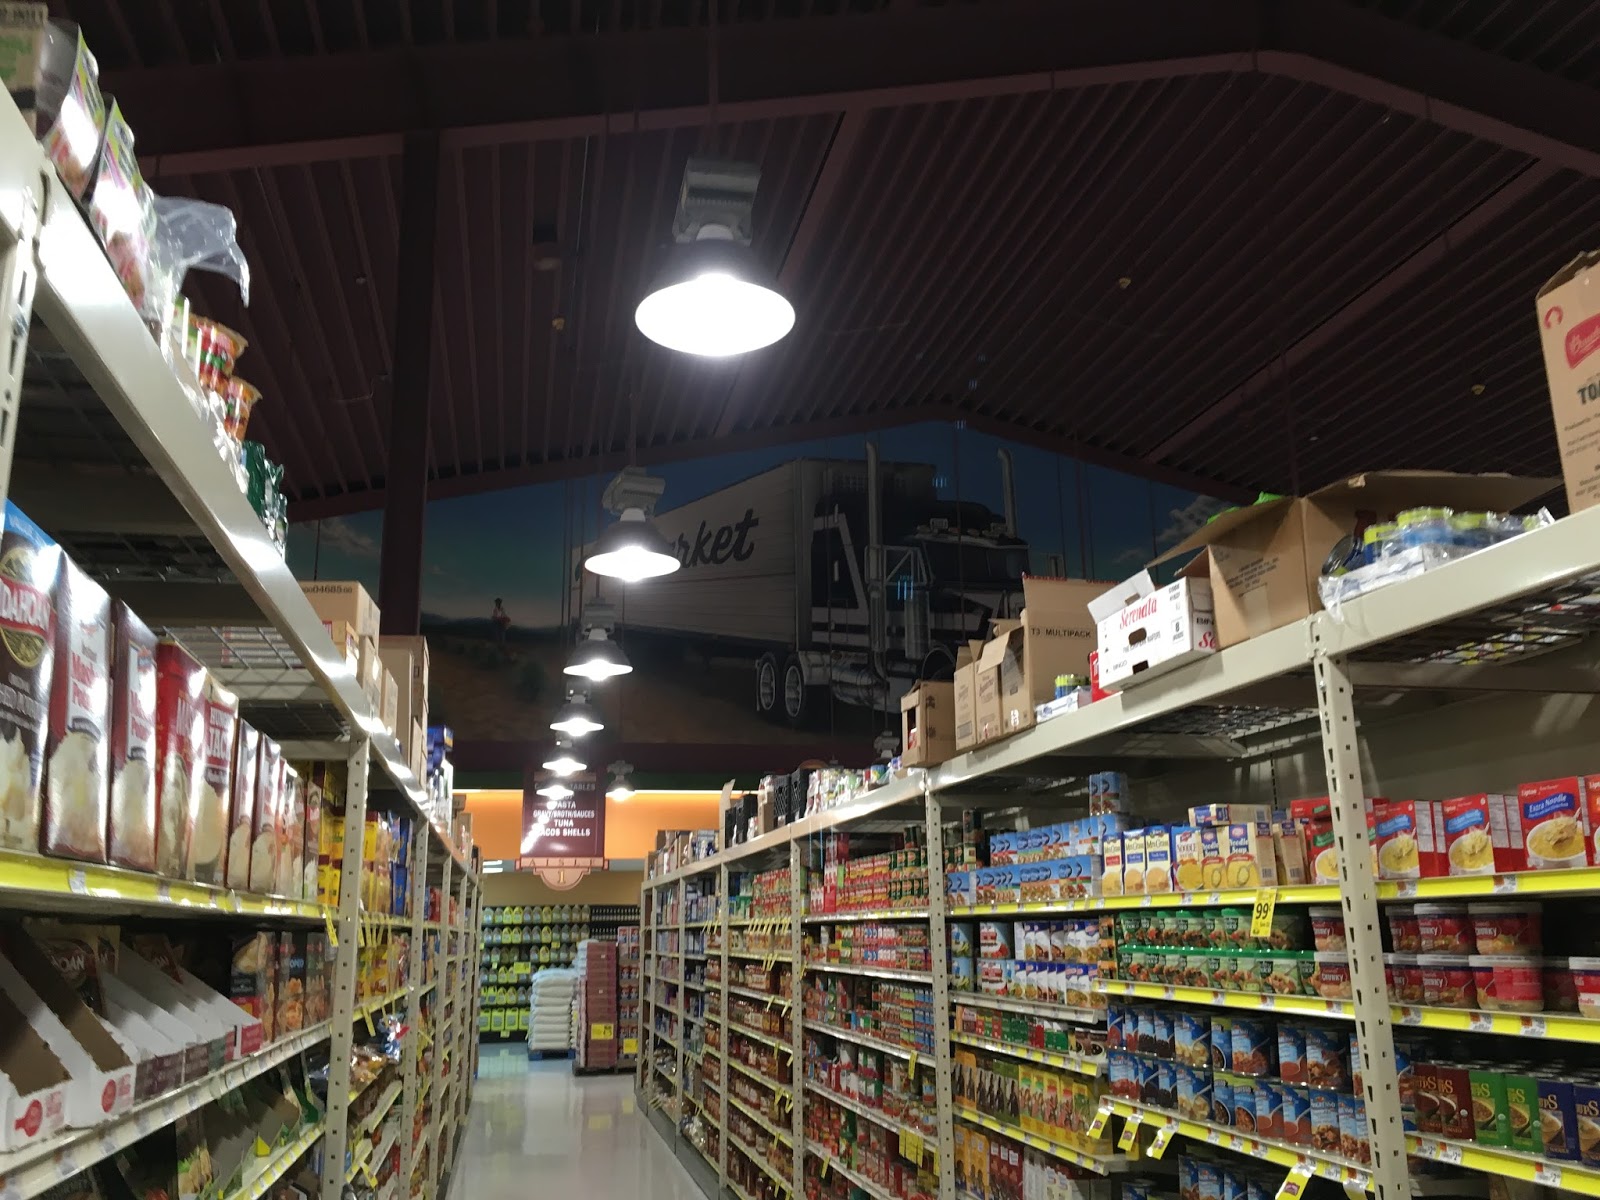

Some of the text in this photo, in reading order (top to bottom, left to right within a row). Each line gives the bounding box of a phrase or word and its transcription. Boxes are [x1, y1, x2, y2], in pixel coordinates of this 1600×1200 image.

[673, 508, 759, 568] rket
[0, 577, 50, 632] DAHOAN
[1120, 598, 1158, 630] Serenata
[1045, 628, 1091, 639] MULTIPACK
[1529, 802, 1544, 813] Extra
[1545, 794, 1567, 806] Noodle
[554, 819, 574, 827] TUNA
[562, 828, 591, 836] SHELLS
